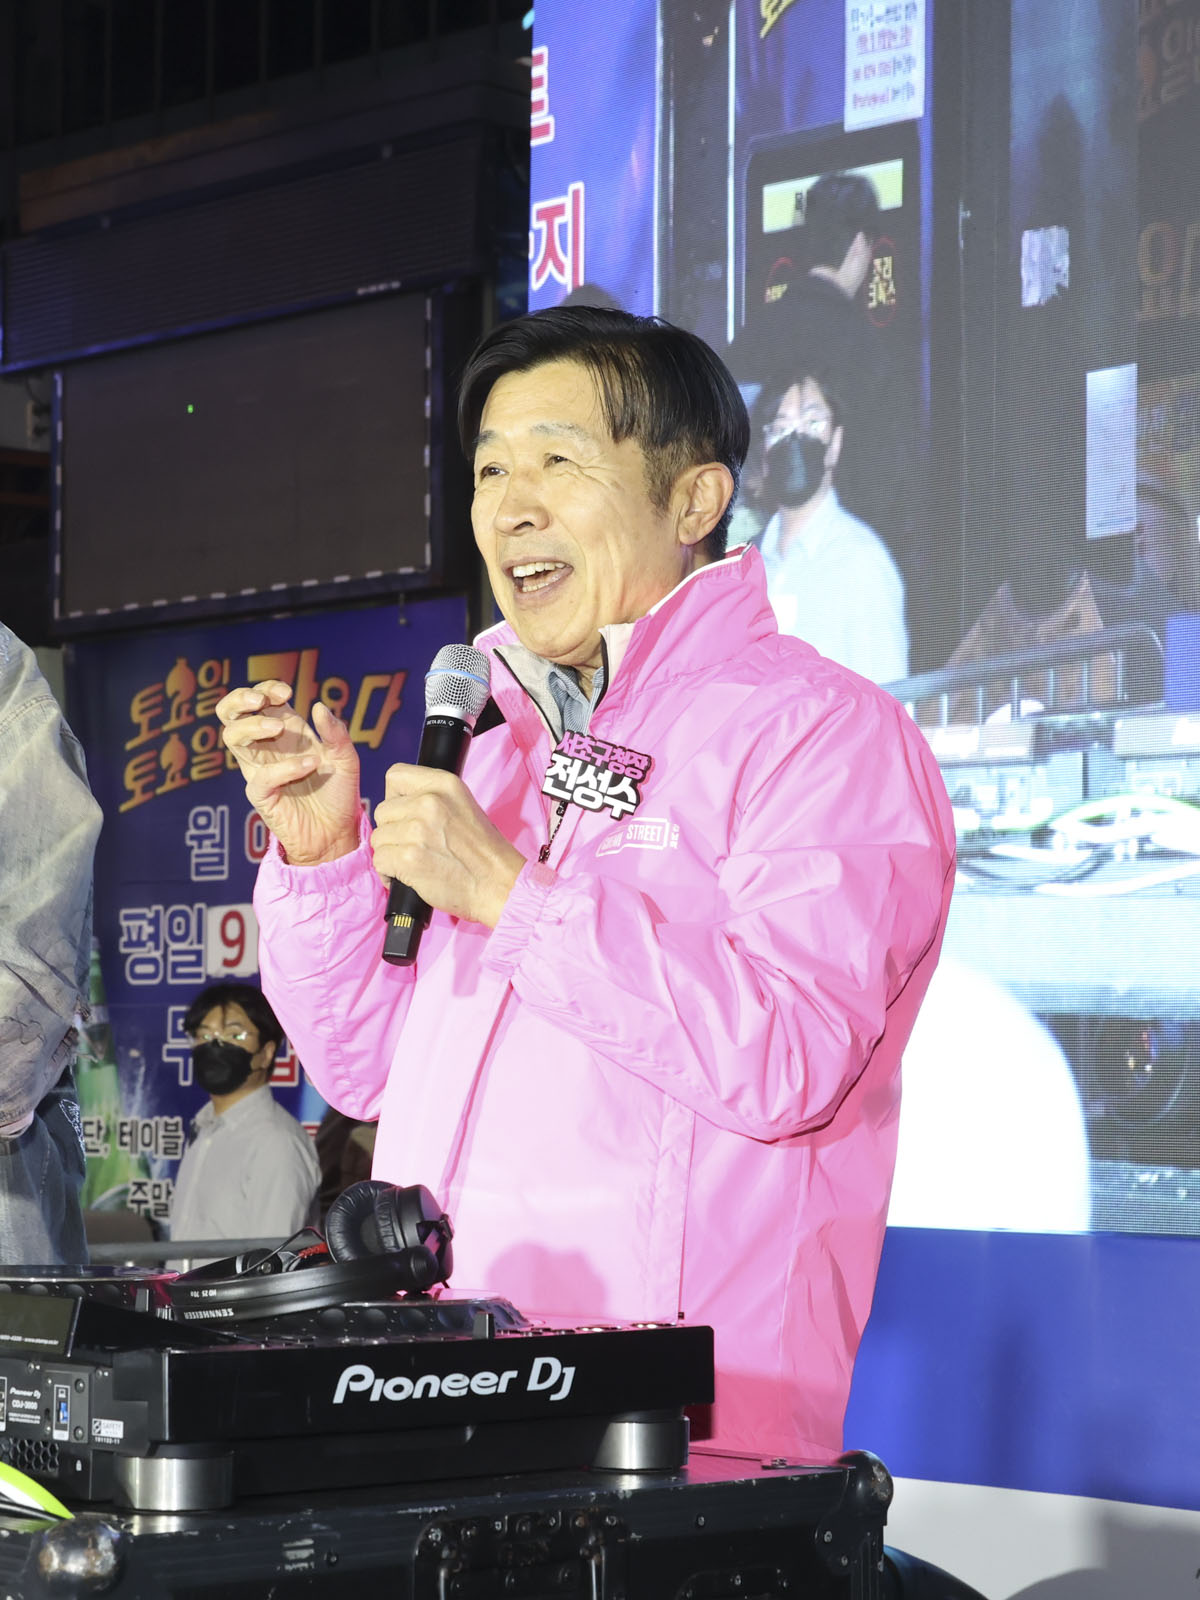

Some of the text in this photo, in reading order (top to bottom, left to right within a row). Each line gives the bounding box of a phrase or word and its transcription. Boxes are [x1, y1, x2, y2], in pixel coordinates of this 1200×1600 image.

[118, 733, 240, 814] 토요일
[541, 752, 638, 819] 전성수
[626, 824, 663, 842] STREET
[117, 1117, 184, 1159] 테이블
[183, 1307, 234, 1320] SENNHEISER
[332, 1362, 517, 1404] Pioneer
